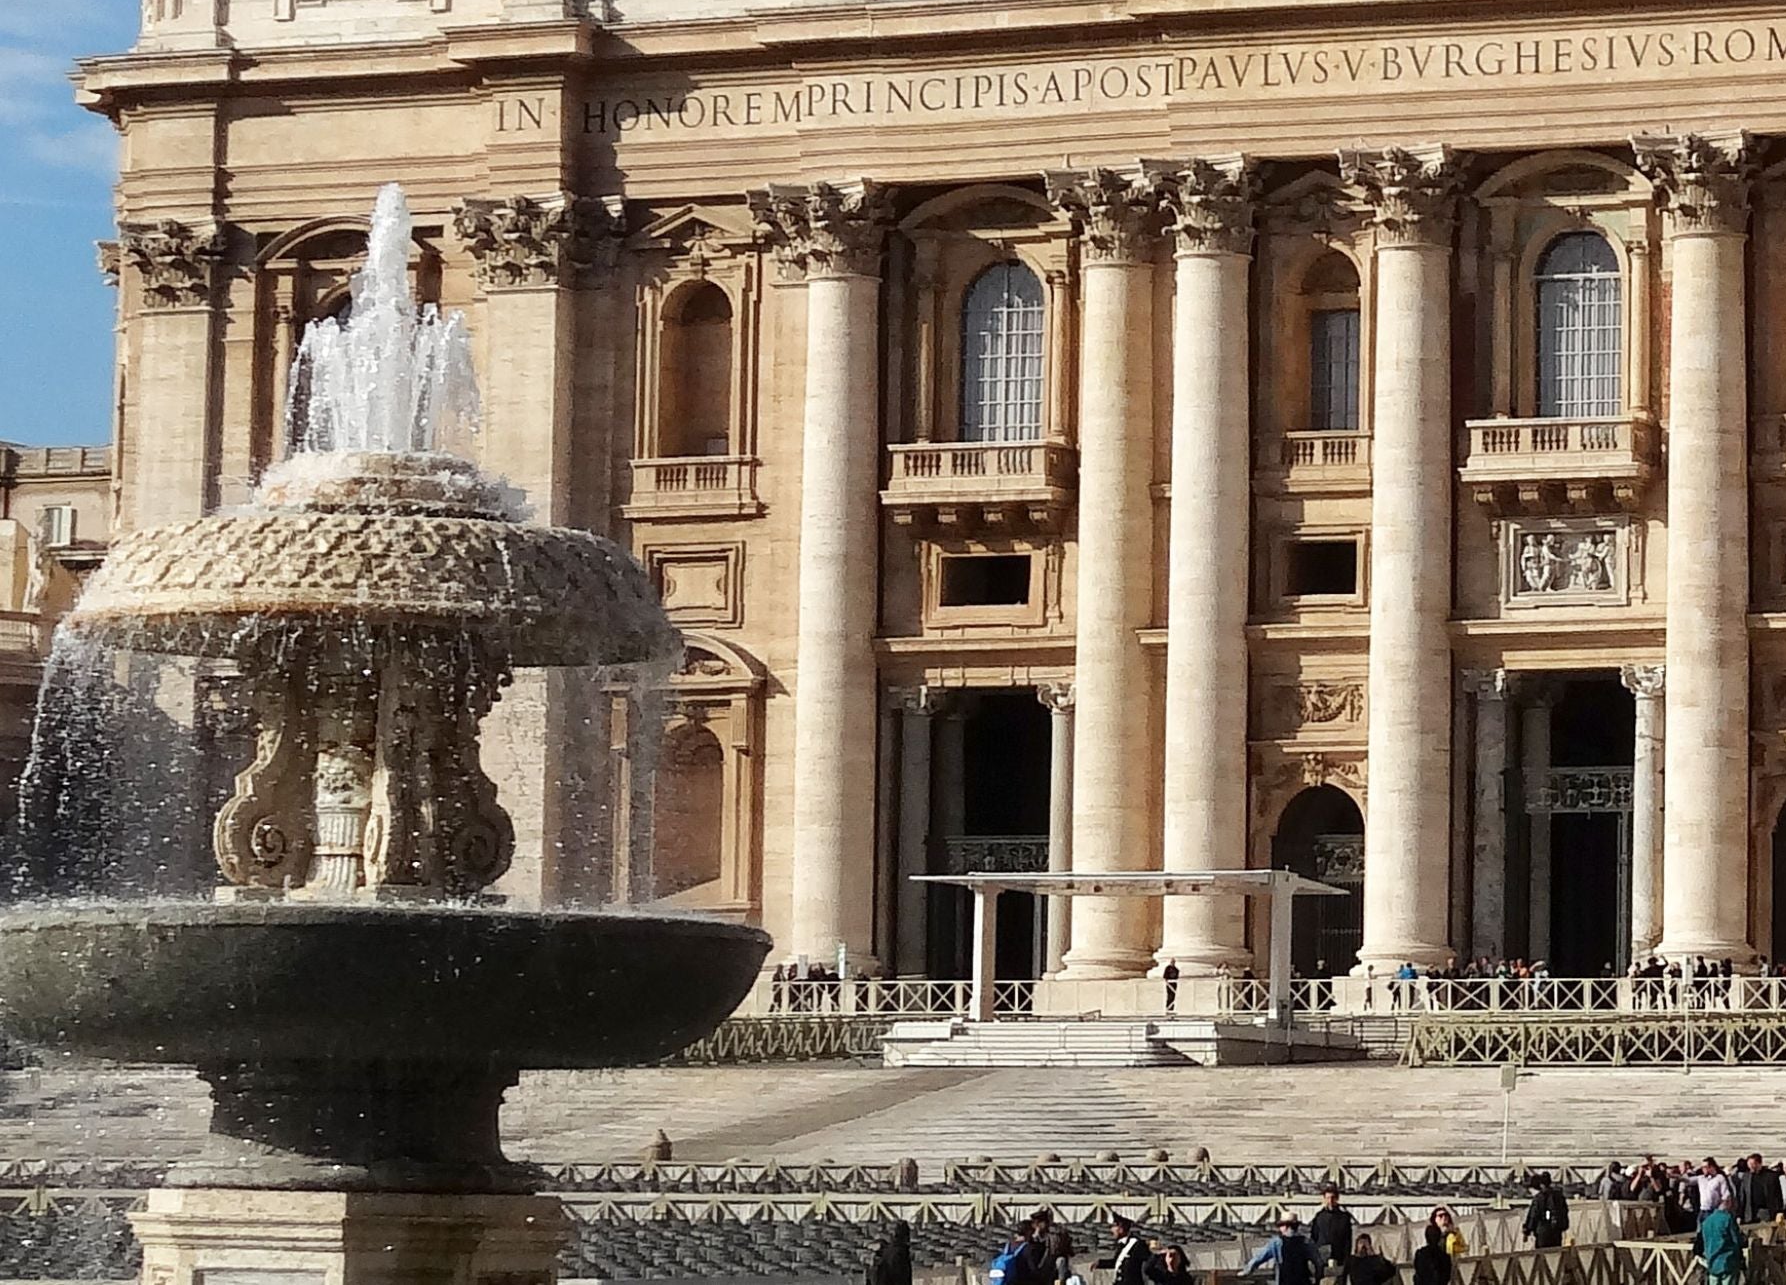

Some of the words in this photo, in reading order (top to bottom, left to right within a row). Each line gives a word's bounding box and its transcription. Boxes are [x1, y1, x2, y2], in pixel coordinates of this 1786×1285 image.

[495, 96, 546, 132] IN
[582, 90, 803, 134] HONOREM
[805, 71, 1029, 116] PRINCIPIS
[1175, 51, 1329, 91] PAVLVS
[1380, 32, 1675, 81] BVRGHESIVS
